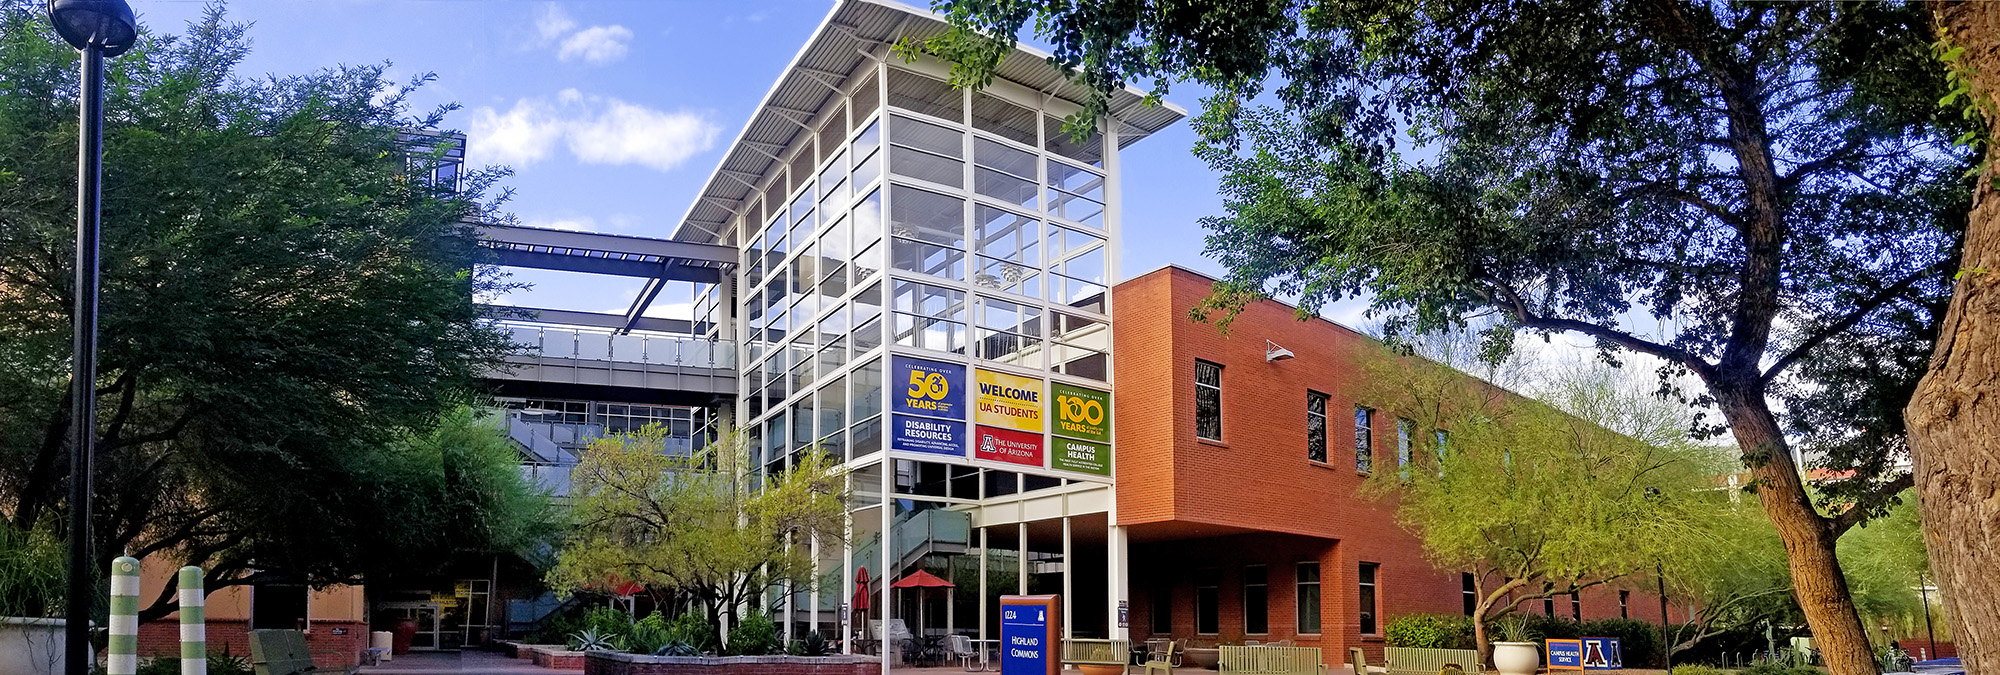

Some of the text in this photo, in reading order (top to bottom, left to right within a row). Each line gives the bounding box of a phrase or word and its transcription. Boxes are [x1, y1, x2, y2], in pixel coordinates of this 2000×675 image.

[905, 363, 938, 372] CELEBRATING
[979, 382, 1038, 402] WELCOME
[905, 398, 937, 410] YEARS
[979, 402, 1039, 419] UA STUDENTS
[1056, 395, 1104, 426] 100
[905, 420, 951, 432] DISABILITY
[1060, 421, 1086, 433] YEARS
[905, 429, 952, 441] RESOURCES
[995, 438, 1038, 450] THE UNIVERSITY
[1066, 443, 1096, 453] CAMPUS
[1008, 448, 1034, 457] ARIZONA
[1067, 451, 1095, 461] HEALTH
[1004, 610, 1017, 619] 1224
[1011, 636, 1039, 646] HIGHLAND
[1011, 648, 1039, 659] COMMONS
[1583, 640, 1608, 667] A
[1610, 640, 1622, 668] A
